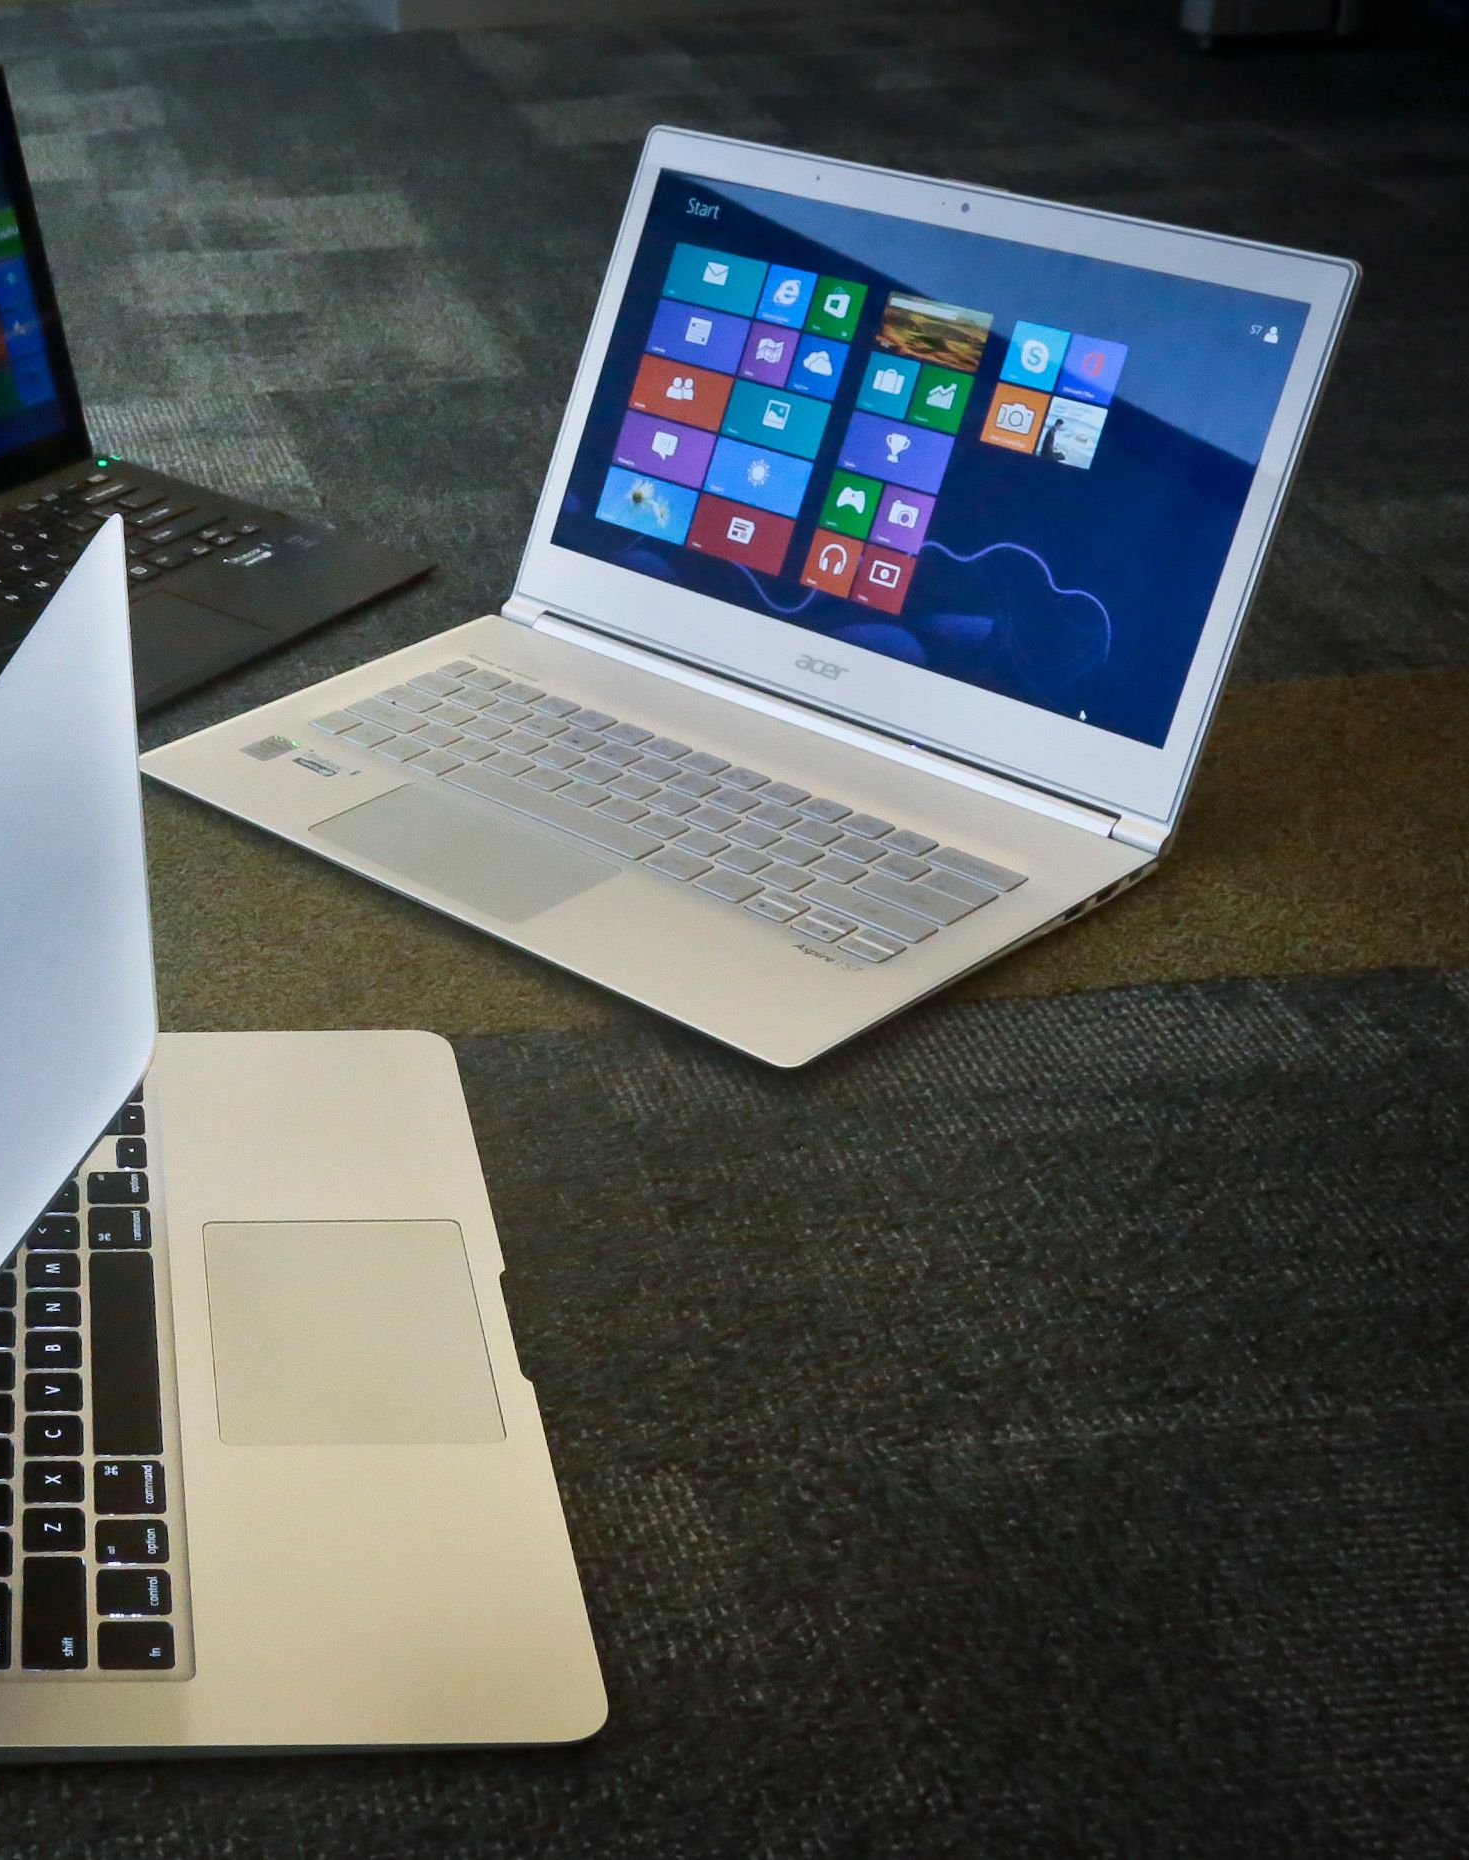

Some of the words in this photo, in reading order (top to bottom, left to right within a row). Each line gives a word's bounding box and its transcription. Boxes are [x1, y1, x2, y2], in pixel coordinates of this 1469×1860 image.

[686, 198, 721, 220] Start
[794, 653, 851, 682] acer
[793, 944, 835, 963] Aspire
[46, 1264, 60, 1273] M
[46, 1303, 60, 1311] N
[45, 1386, 60, 1394] V
[45, 1430, 61, 1438] C
[45, 1475, 61, 1484] X
[142, 1464, 154, 1504] command
[44, 1523, 61, 1532] Z
[147, 1528, 159, 1555] option
[147, 1576, 159, 1607] control
[64, 1636, 74, 1658] shift
[149, 1647, 161, 1657] fn
